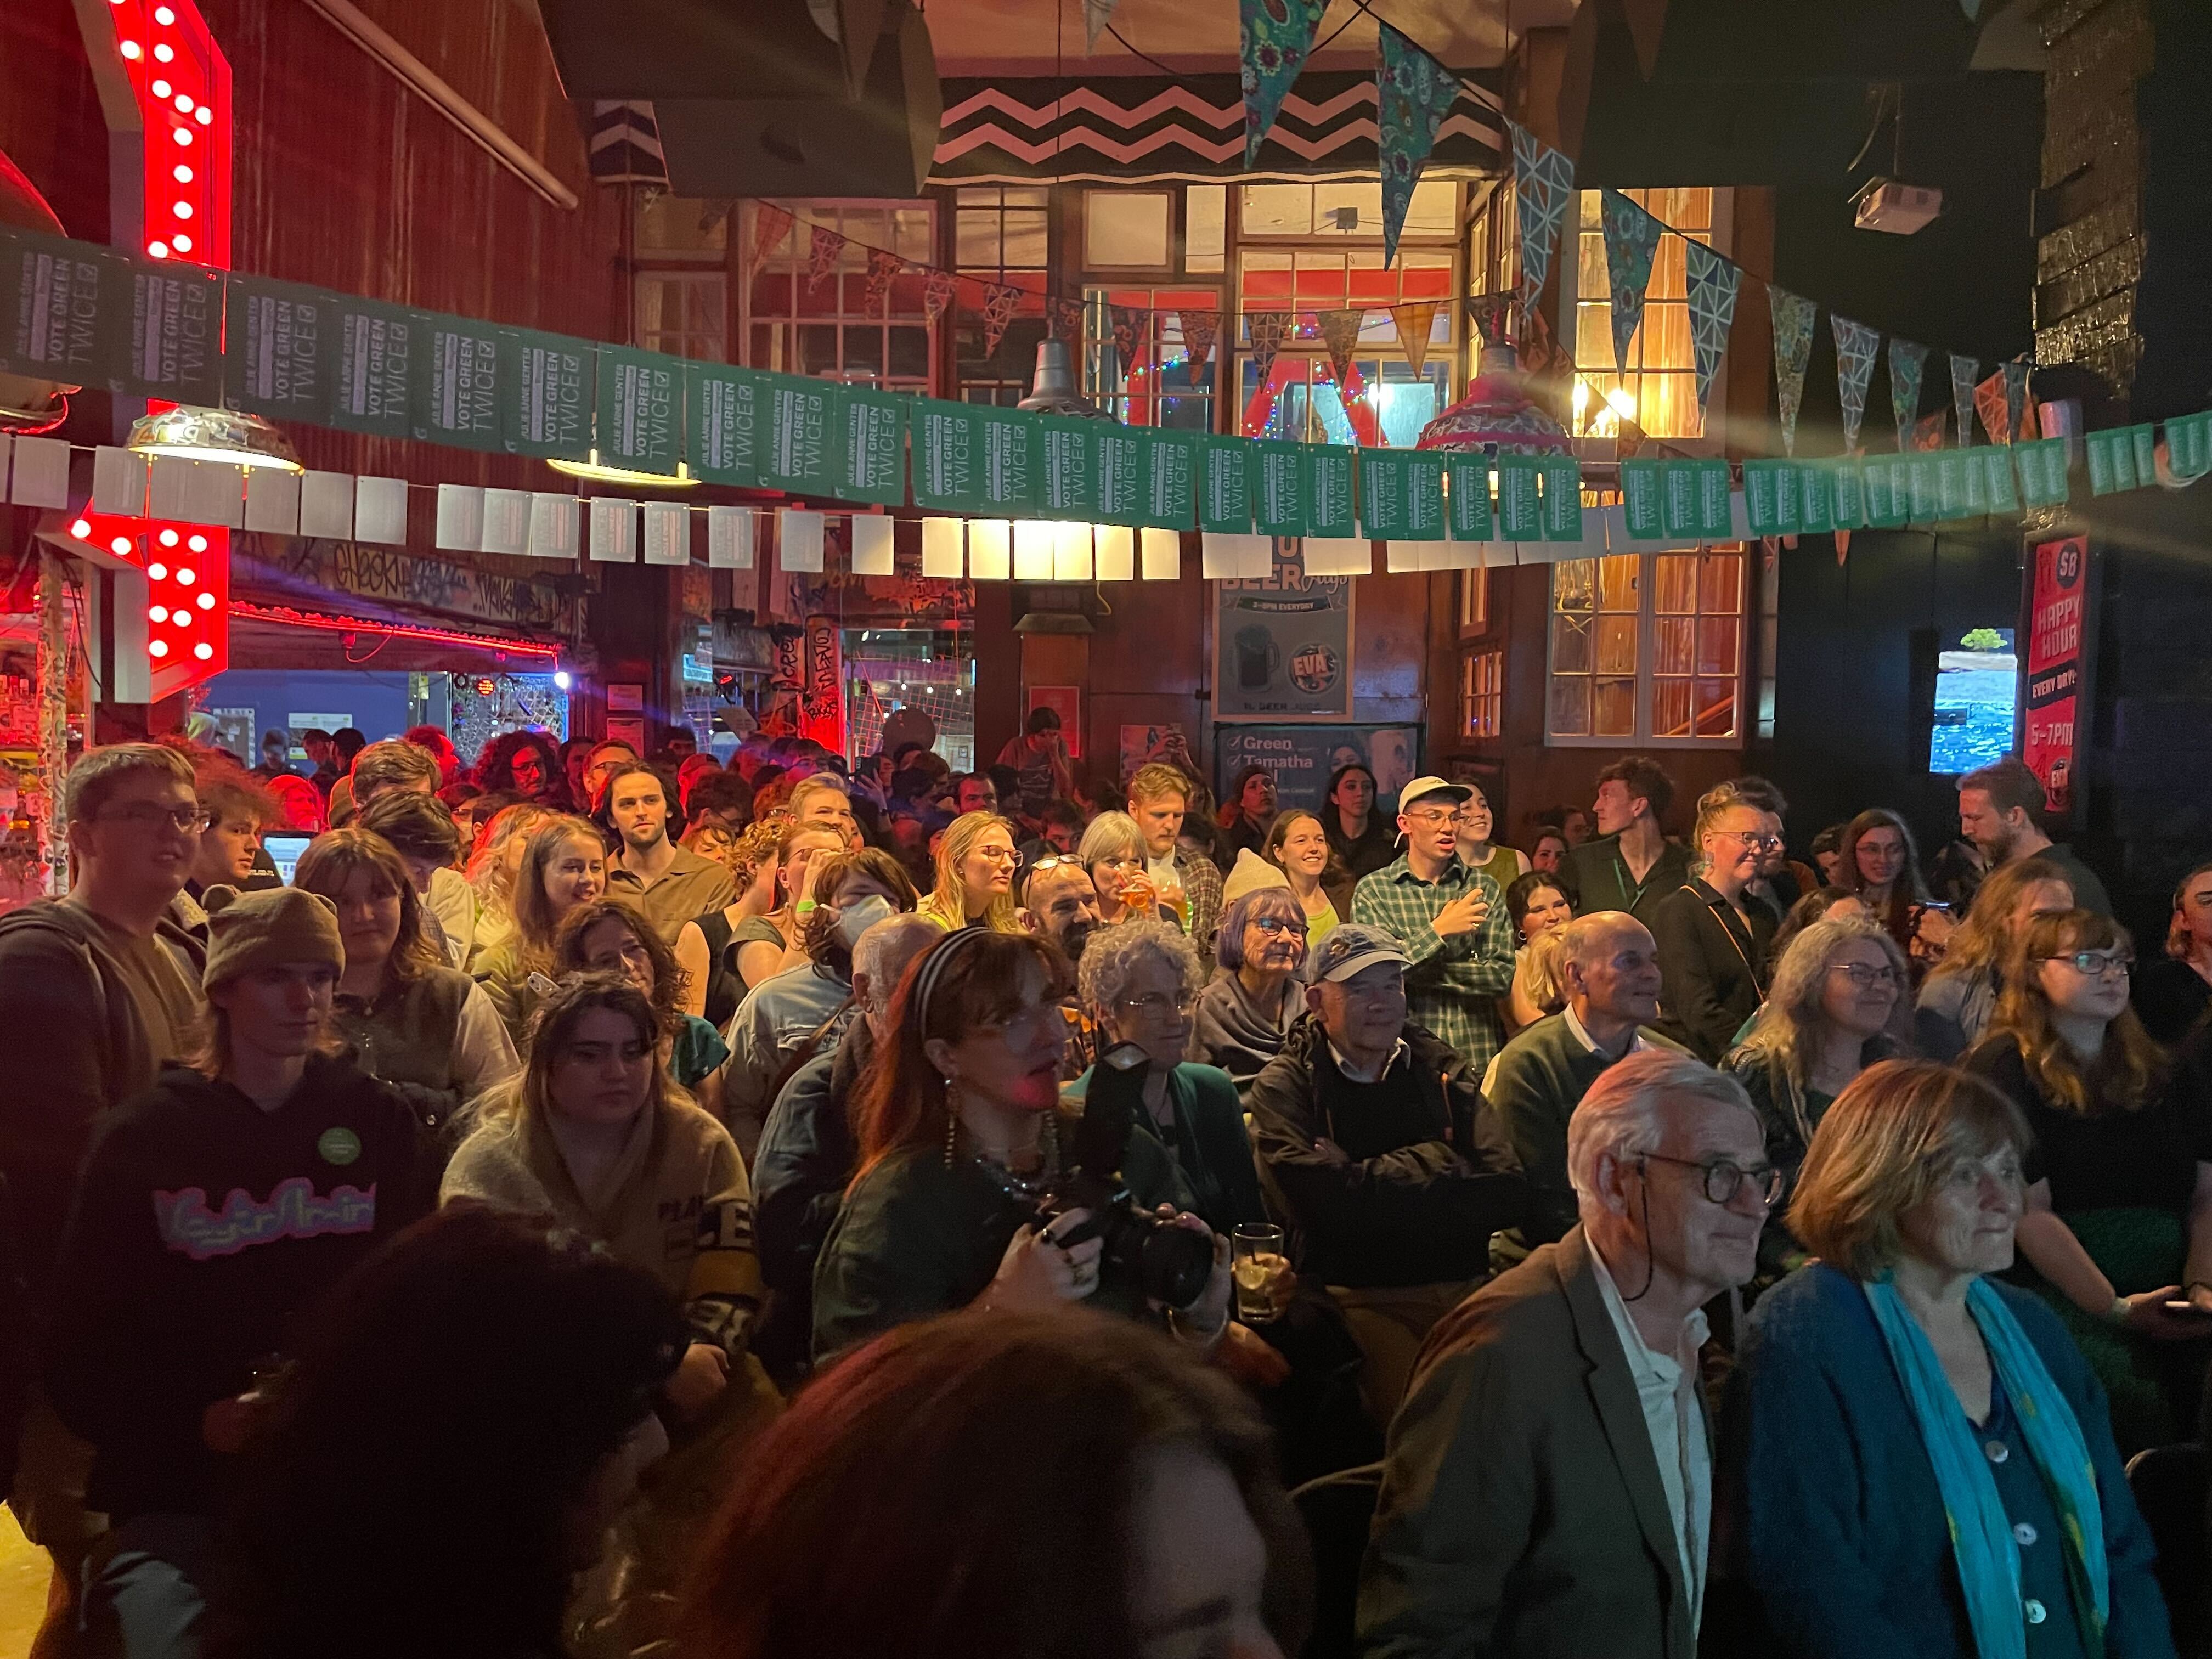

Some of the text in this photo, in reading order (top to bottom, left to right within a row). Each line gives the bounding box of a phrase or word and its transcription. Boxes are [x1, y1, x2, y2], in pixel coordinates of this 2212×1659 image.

[275, 301, 291, 399] VOTE GREEN
[368, 319, 385, 415] VOTE GREEN
[385, 342, 407, 419] TWICE
[457, 337, 472, 429] VOTE GREEN
[473, 360, 494, 432] TWICE
[545, 352, 558, 442] VOTE GREEN
[560, 374, 579, 444] TWICE
[615, 364, 624, 400] GENTER
[636, 368, 650, 456] VOTE GREEN
[703, 380, 711, 415] GENTER
[774, 389, 782, 425] GENTER
[650, 389, 669, 459] TWICE
[724, 382, 735, 469] VOTE GREEN
[736, 403, 753, 470] TWICE
[792, 393, 805, 476] VOTE GREEN
[804, 413, 822, 478] TWICE
[849, 403, 857, 437] GENTER
[867, 407, 878, 487] VOTE GREEN
[1003, 424, 1011, 465] GREEN
[878, 426, 894, 489] TWICE
[944, 417, 952, 495] VOTE GREEN
[955, 435, 970, 496] TWICE
[1013, 441, 1026, 503] TWICE
[1062, 432, 1070, 507] VOTE GREEN
[1072, 449, 1086, 509] TWICE
[1114, 439, 1123, 513] VOTE GREEN
[1123, 454, 1137, 514] TWICE
[1164, 444, 1174, 516] VOTE GREEN
[1174, 461, 1187, 517] TWICE
[1232, 466, 1243, 521] TWICE
[1286, 470, 1298, 523] TWICE
[1336, 472, 1347, 526] TWICE
[2038, 594, 2081, 634] HAPPY
[2042, 624, 2078, 659] HOUR
[2032, 676, 2056, 698] EVERY
[1243, 736, 1292, 750] Green
[1243, 754, 1313, 768] Tamatha
[2032, 723, 2074, 747] 5-7PM
